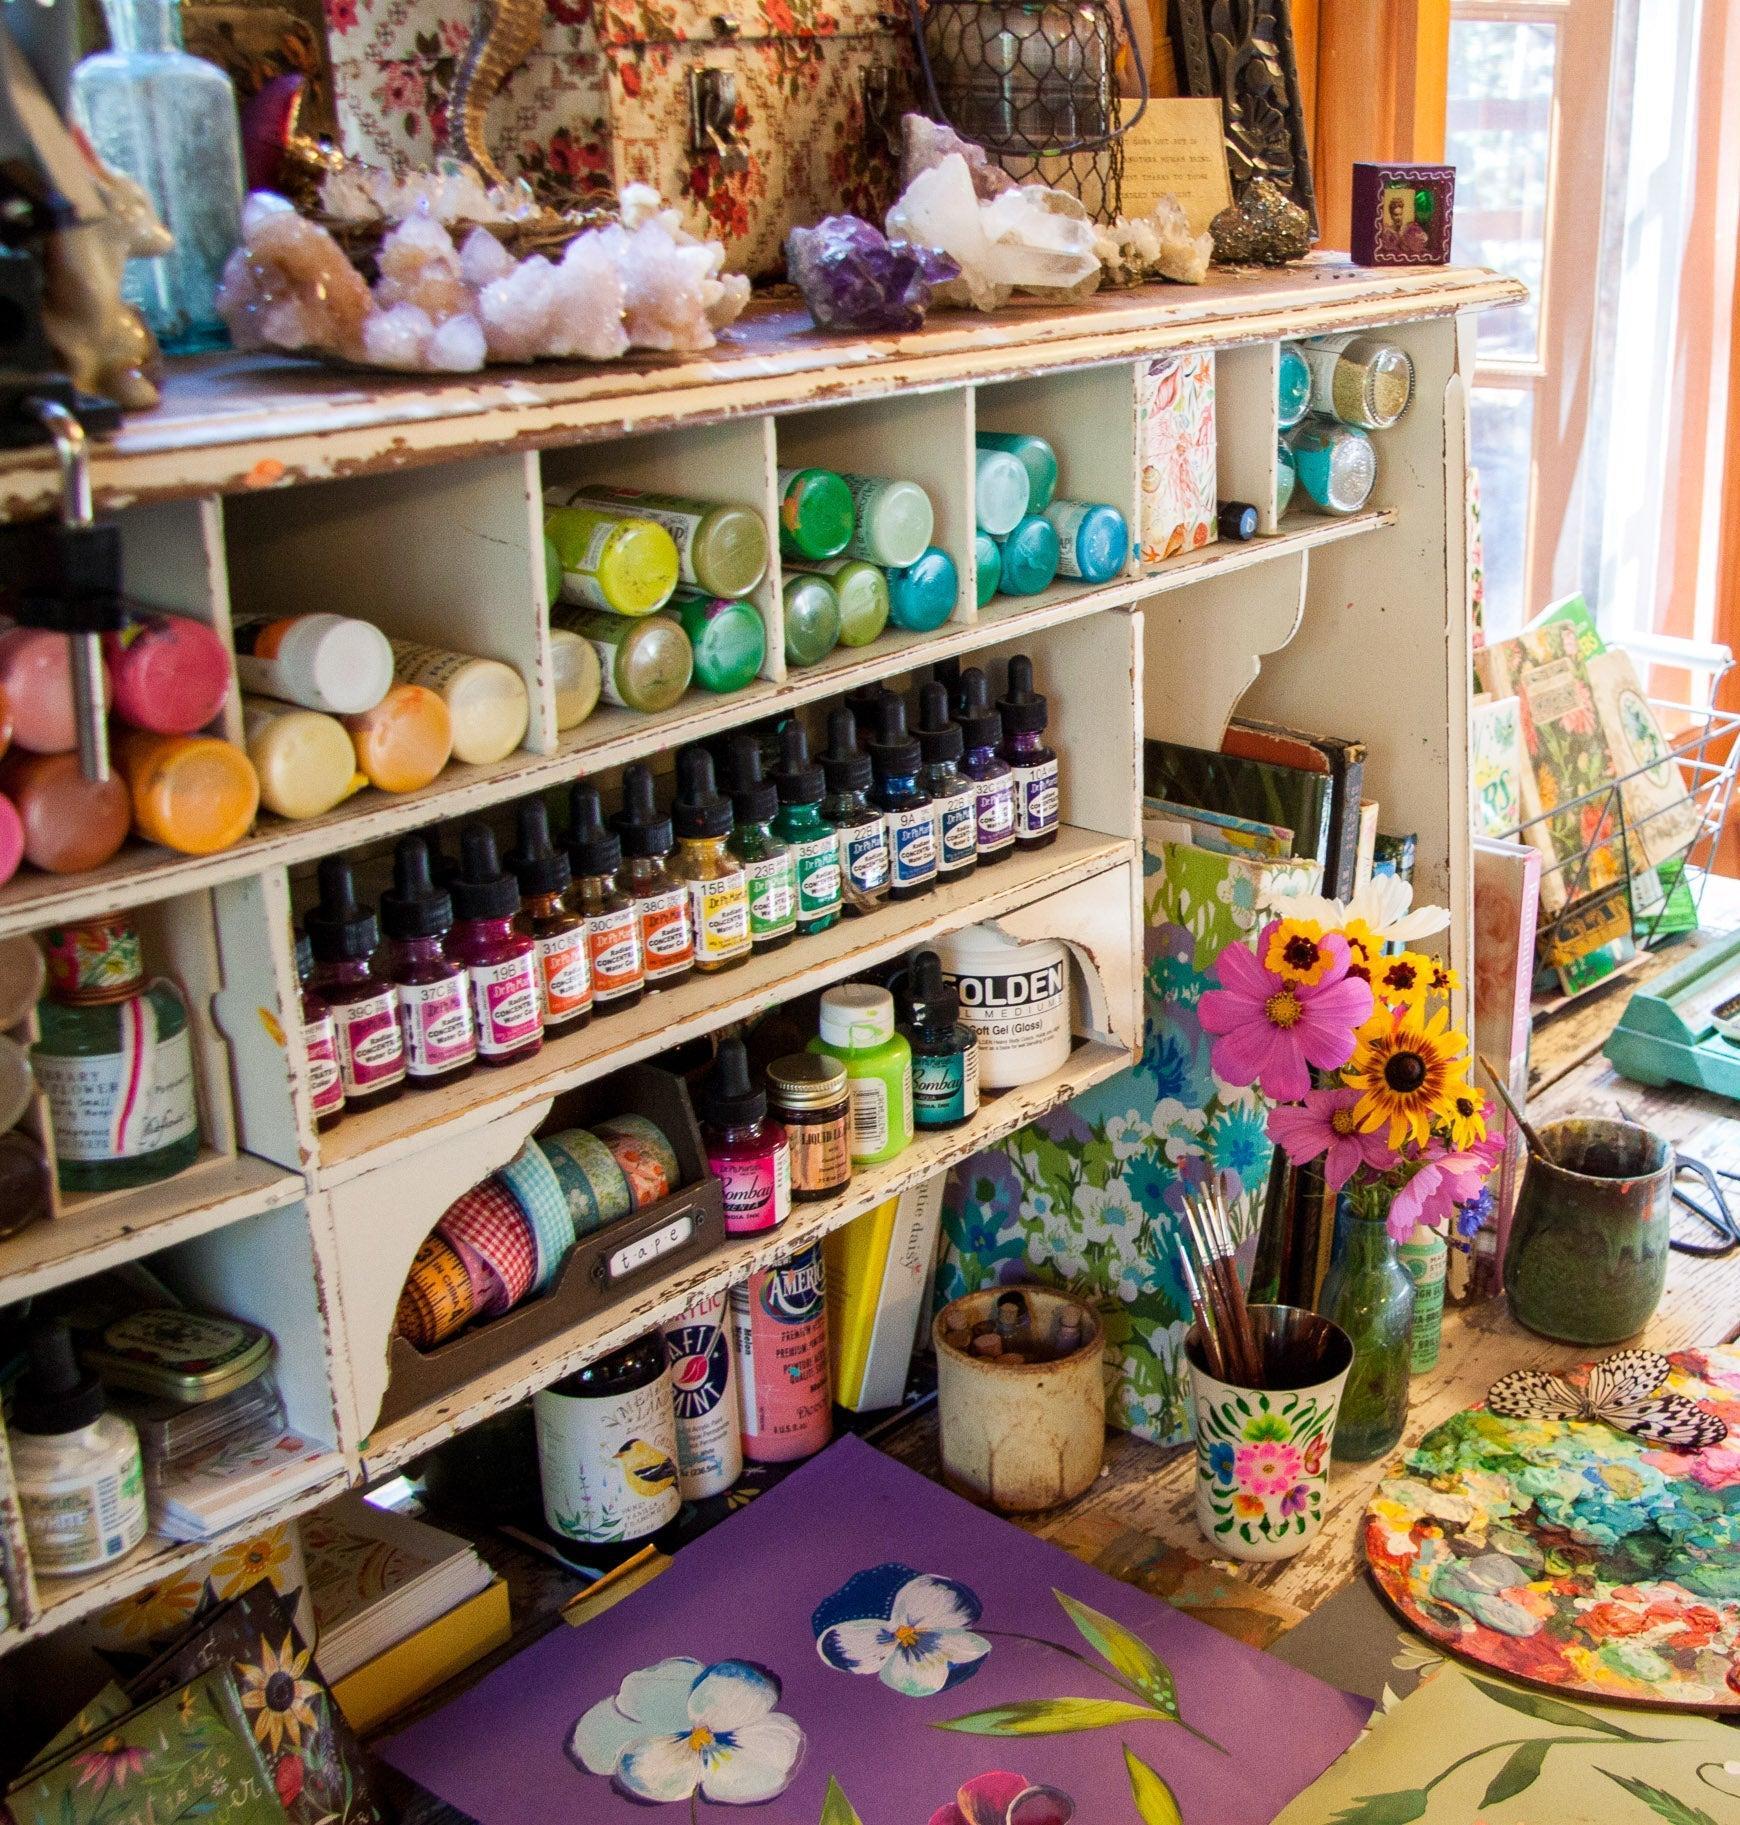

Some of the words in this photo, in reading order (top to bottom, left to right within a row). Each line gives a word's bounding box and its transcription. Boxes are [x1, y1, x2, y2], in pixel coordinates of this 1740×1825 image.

[900, 814, 915, 827] 9A
[800, 845, 818, 857] 35C
[701, 881, 724, 896] 15B
[643, 899, 664, 913] 38C
[591, 918, 613, 932] 30C
[543, 939, 565, 955] 31C
[493, 964, 516, 981] 19B
[421, 985, 445, 1001] 37C
[949, 964, 1062, 1006] OLDEN
[348, 1004, 372, 1021] 39C
[993, 1024, 1009, 1035] Gel
[1011, 1019, 1043, 1036] (Gloss)
[915, 1180, 928, 1218] atie
[899, 1221, 924, 1269] daisy
[443, 1274, 460, 1309] CHINA
[744, 1328, 752, 1355] Melon
